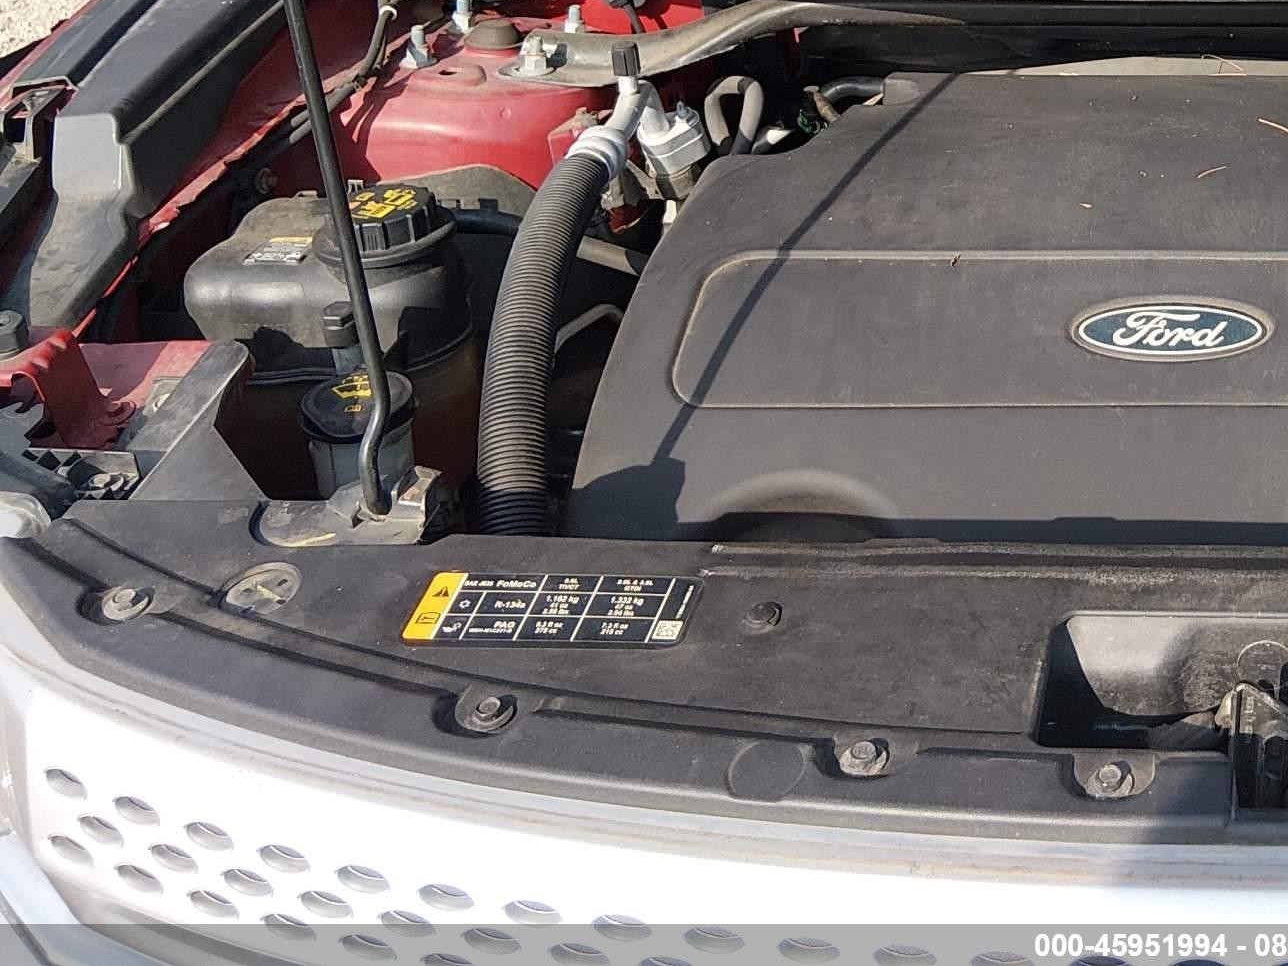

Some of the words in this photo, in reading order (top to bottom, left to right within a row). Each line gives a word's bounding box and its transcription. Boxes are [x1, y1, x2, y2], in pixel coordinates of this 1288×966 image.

[1113, 311, 1228, 346] Ford
[496, 580, 537, 588] FoMoCo
[495, 600, 526, 608] R-134a
[568, 595, 579, 604] kg
[633, 596, 644, 606] kg
